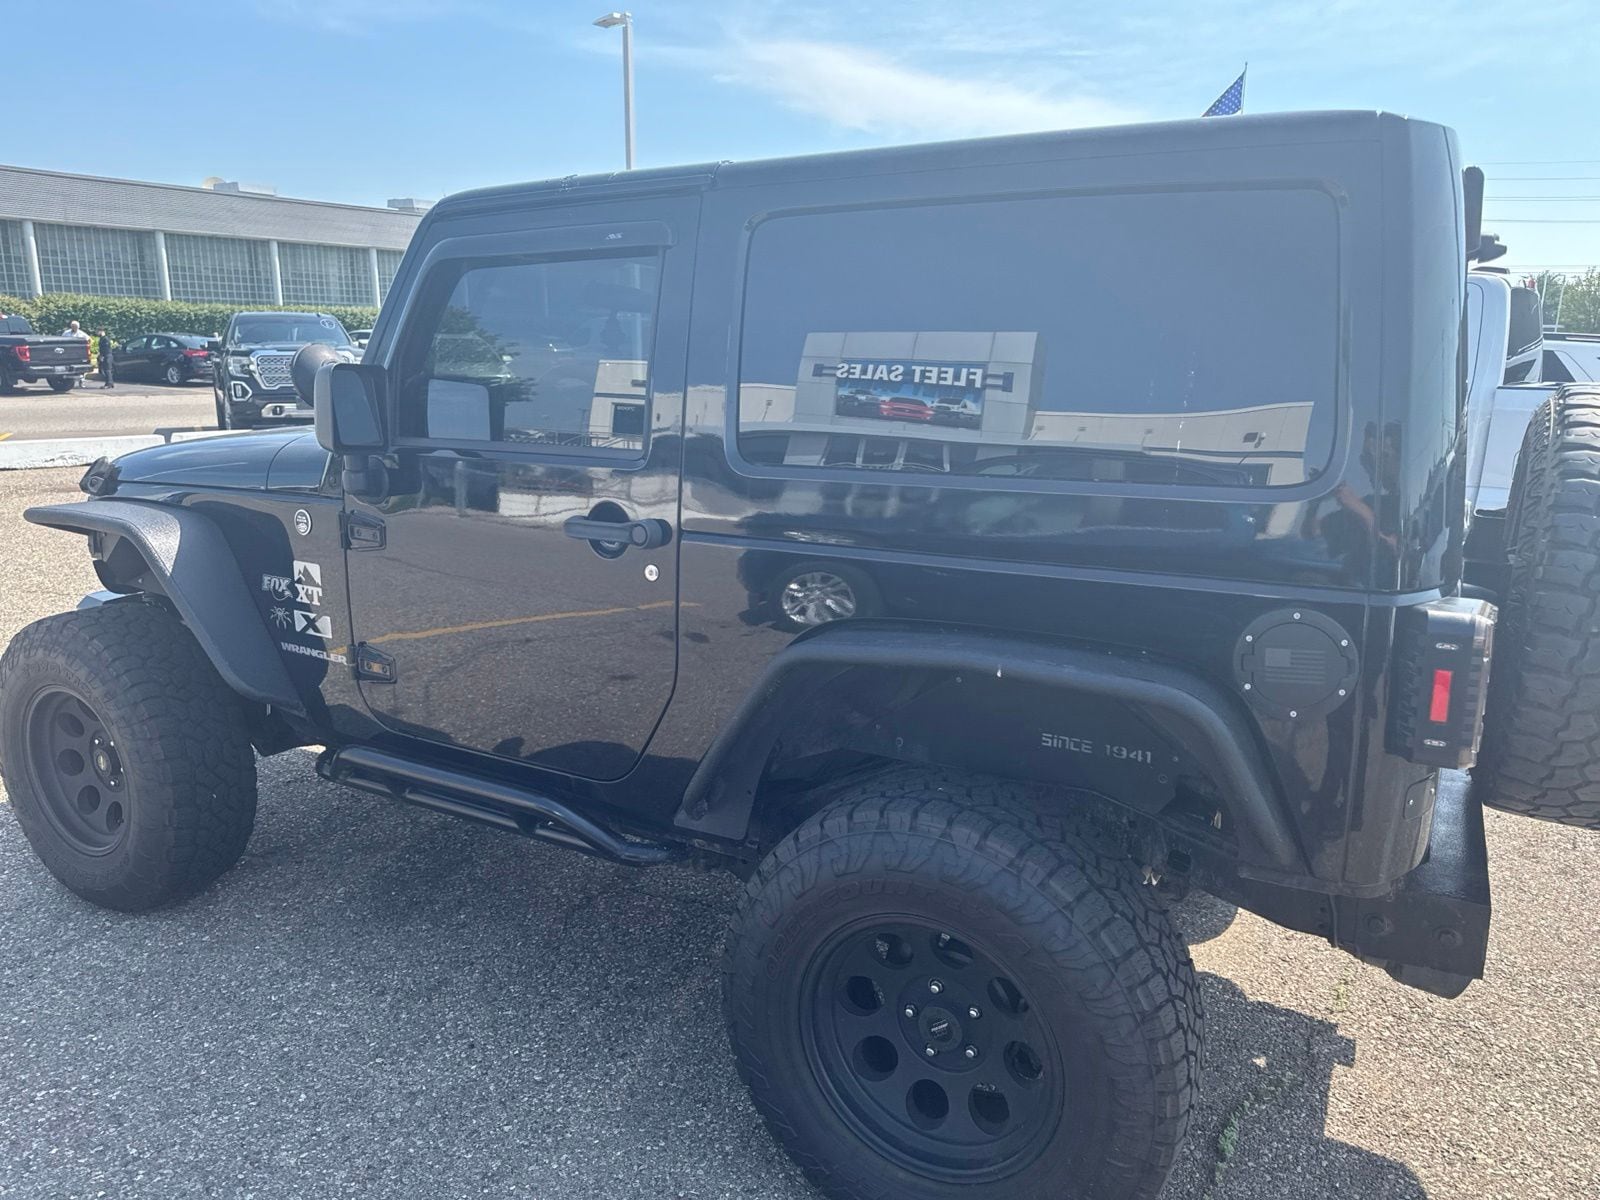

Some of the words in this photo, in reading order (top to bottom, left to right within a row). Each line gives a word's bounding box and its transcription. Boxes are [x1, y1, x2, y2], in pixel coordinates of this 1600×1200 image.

[295, 583, 322, 606] XT
[281, 642, 347, 665] WRANGLER
[1041, 732, 1093, 754] SINCE
[1105, 744, 1152, 764] 1941
